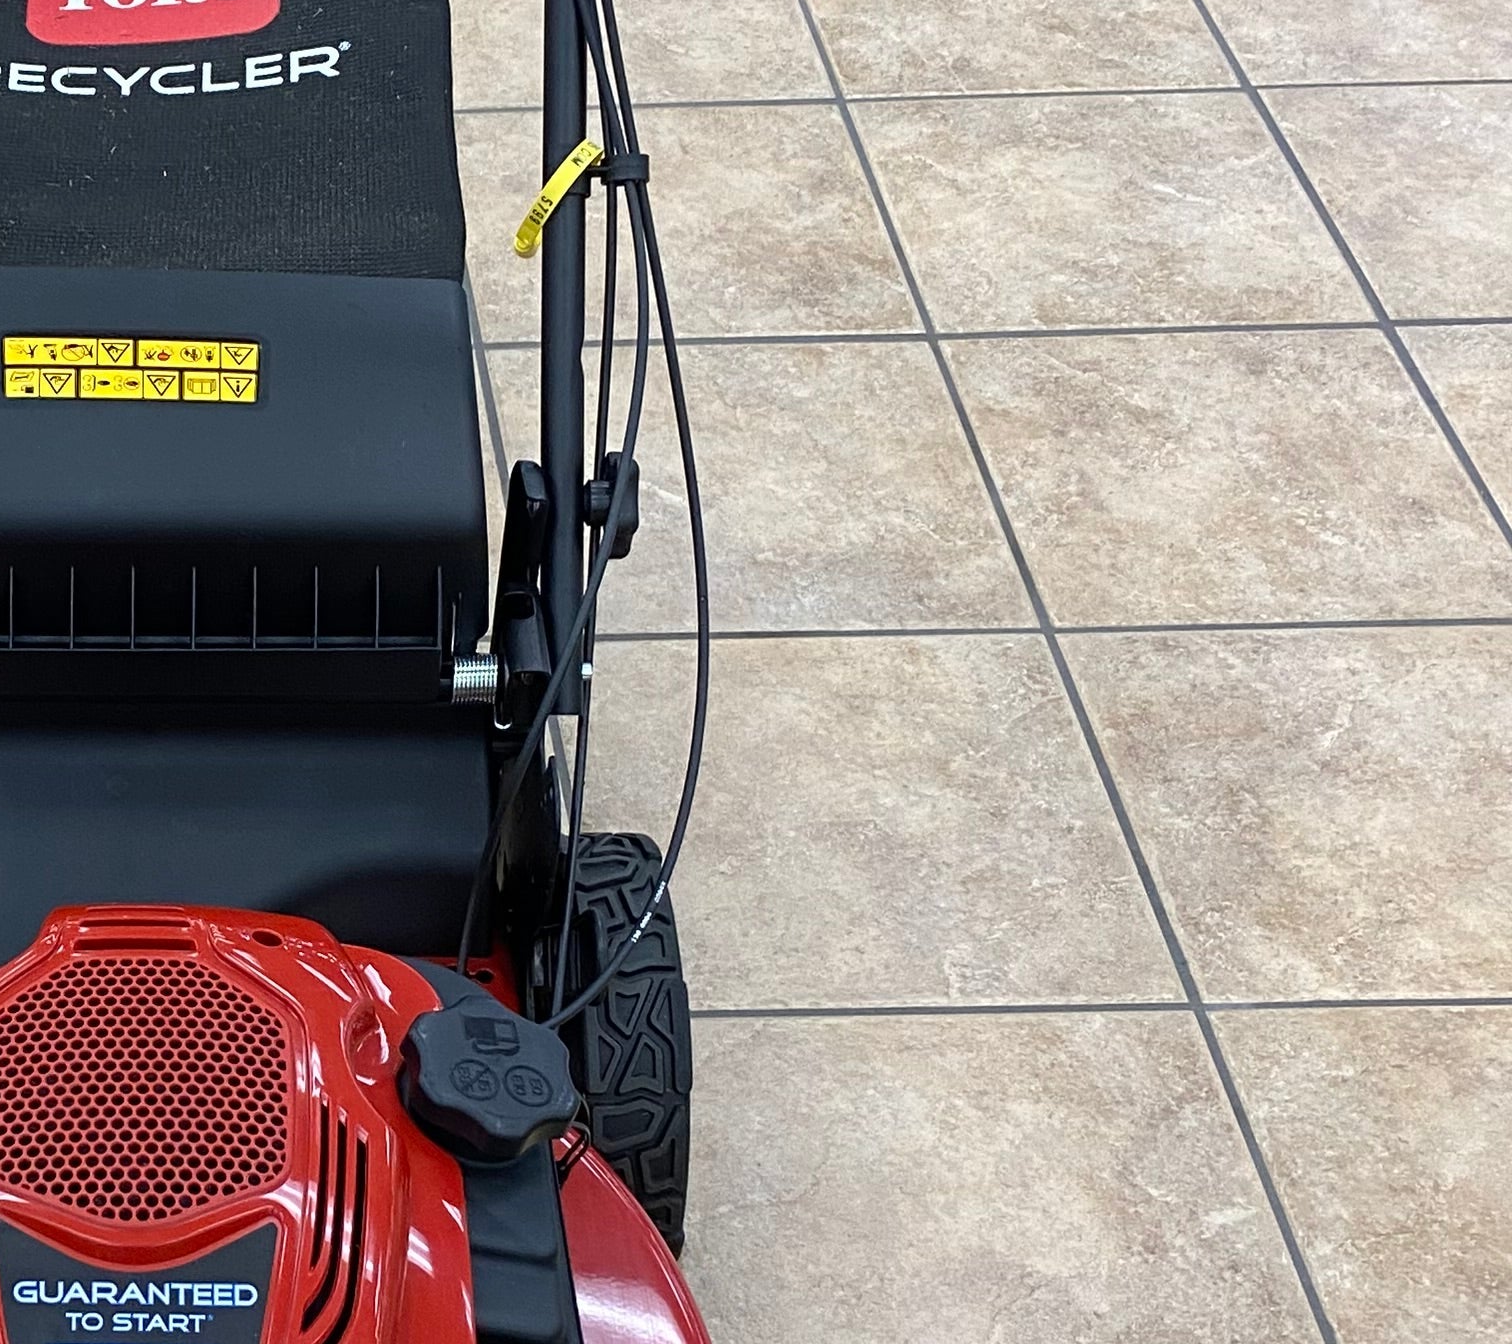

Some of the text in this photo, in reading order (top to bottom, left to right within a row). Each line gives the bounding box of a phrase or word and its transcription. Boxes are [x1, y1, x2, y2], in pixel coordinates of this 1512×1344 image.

[13, 1280, 258, 1306] GUARANTEED
[65, 1312, 206, 1333] TO START
